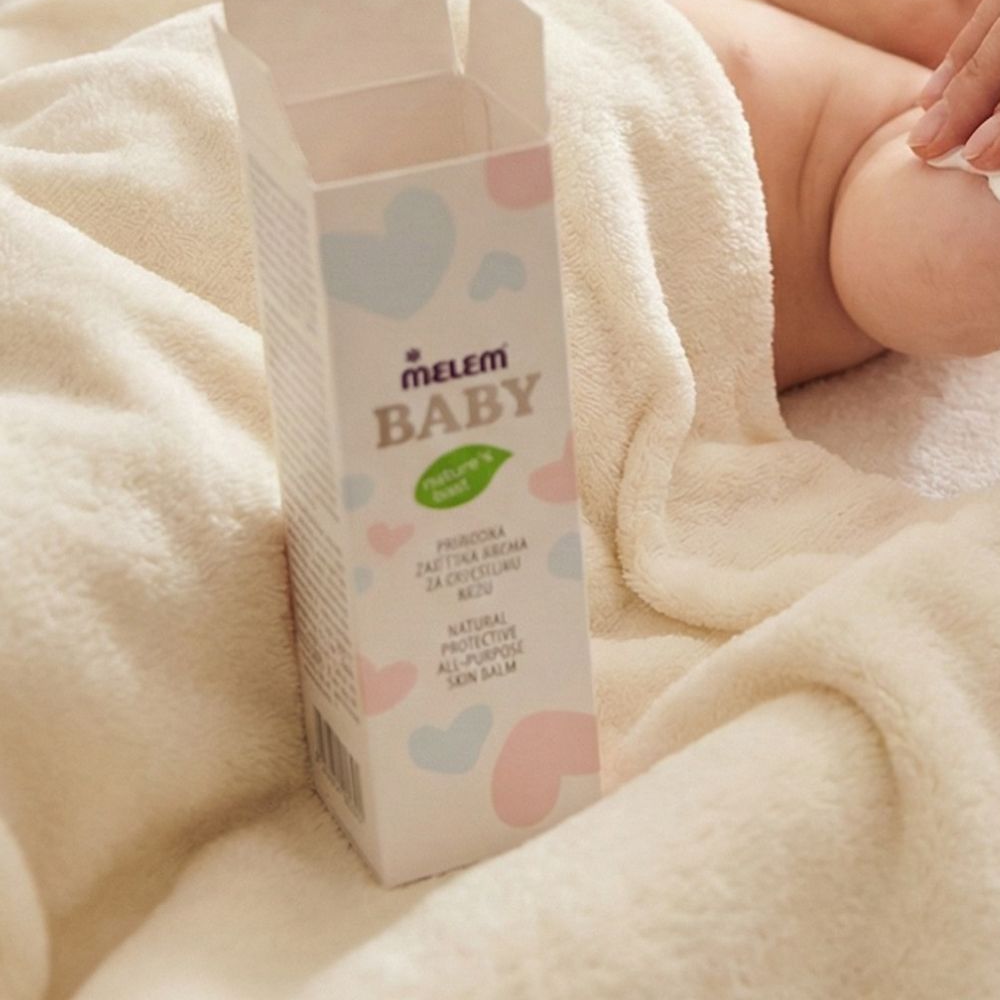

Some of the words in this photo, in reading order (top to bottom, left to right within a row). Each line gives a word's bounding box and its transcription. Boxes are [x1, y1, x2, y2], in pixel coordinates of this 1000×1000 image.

[401, 347, 509, 390] MELEM
[373, 372, 542, 449] BABY
[447, 611, 508, 636] NATURAL
